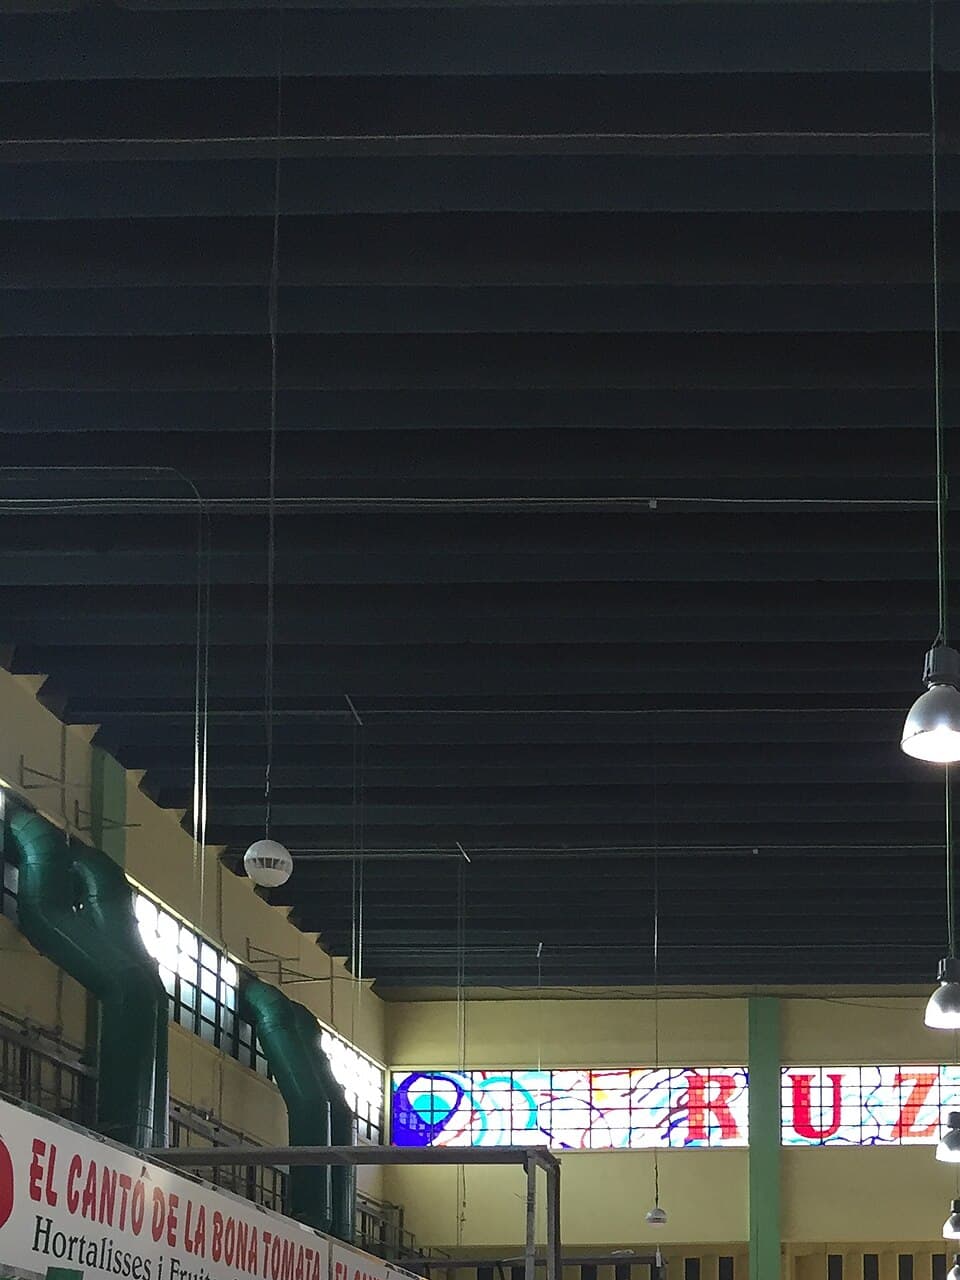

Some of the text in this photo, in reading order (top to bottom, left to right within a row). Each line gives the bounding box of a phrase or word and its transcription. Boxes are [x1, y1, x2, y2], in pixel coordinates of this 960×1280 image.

[28, 1138, 57, 1206] EL
[65, 1154, 147, 1236] CANTÓ
[151, 1186, 179, 1248] DE
[184, 1199, 206, 1260] LA
[211, 1210, 259, 1275] BONA
